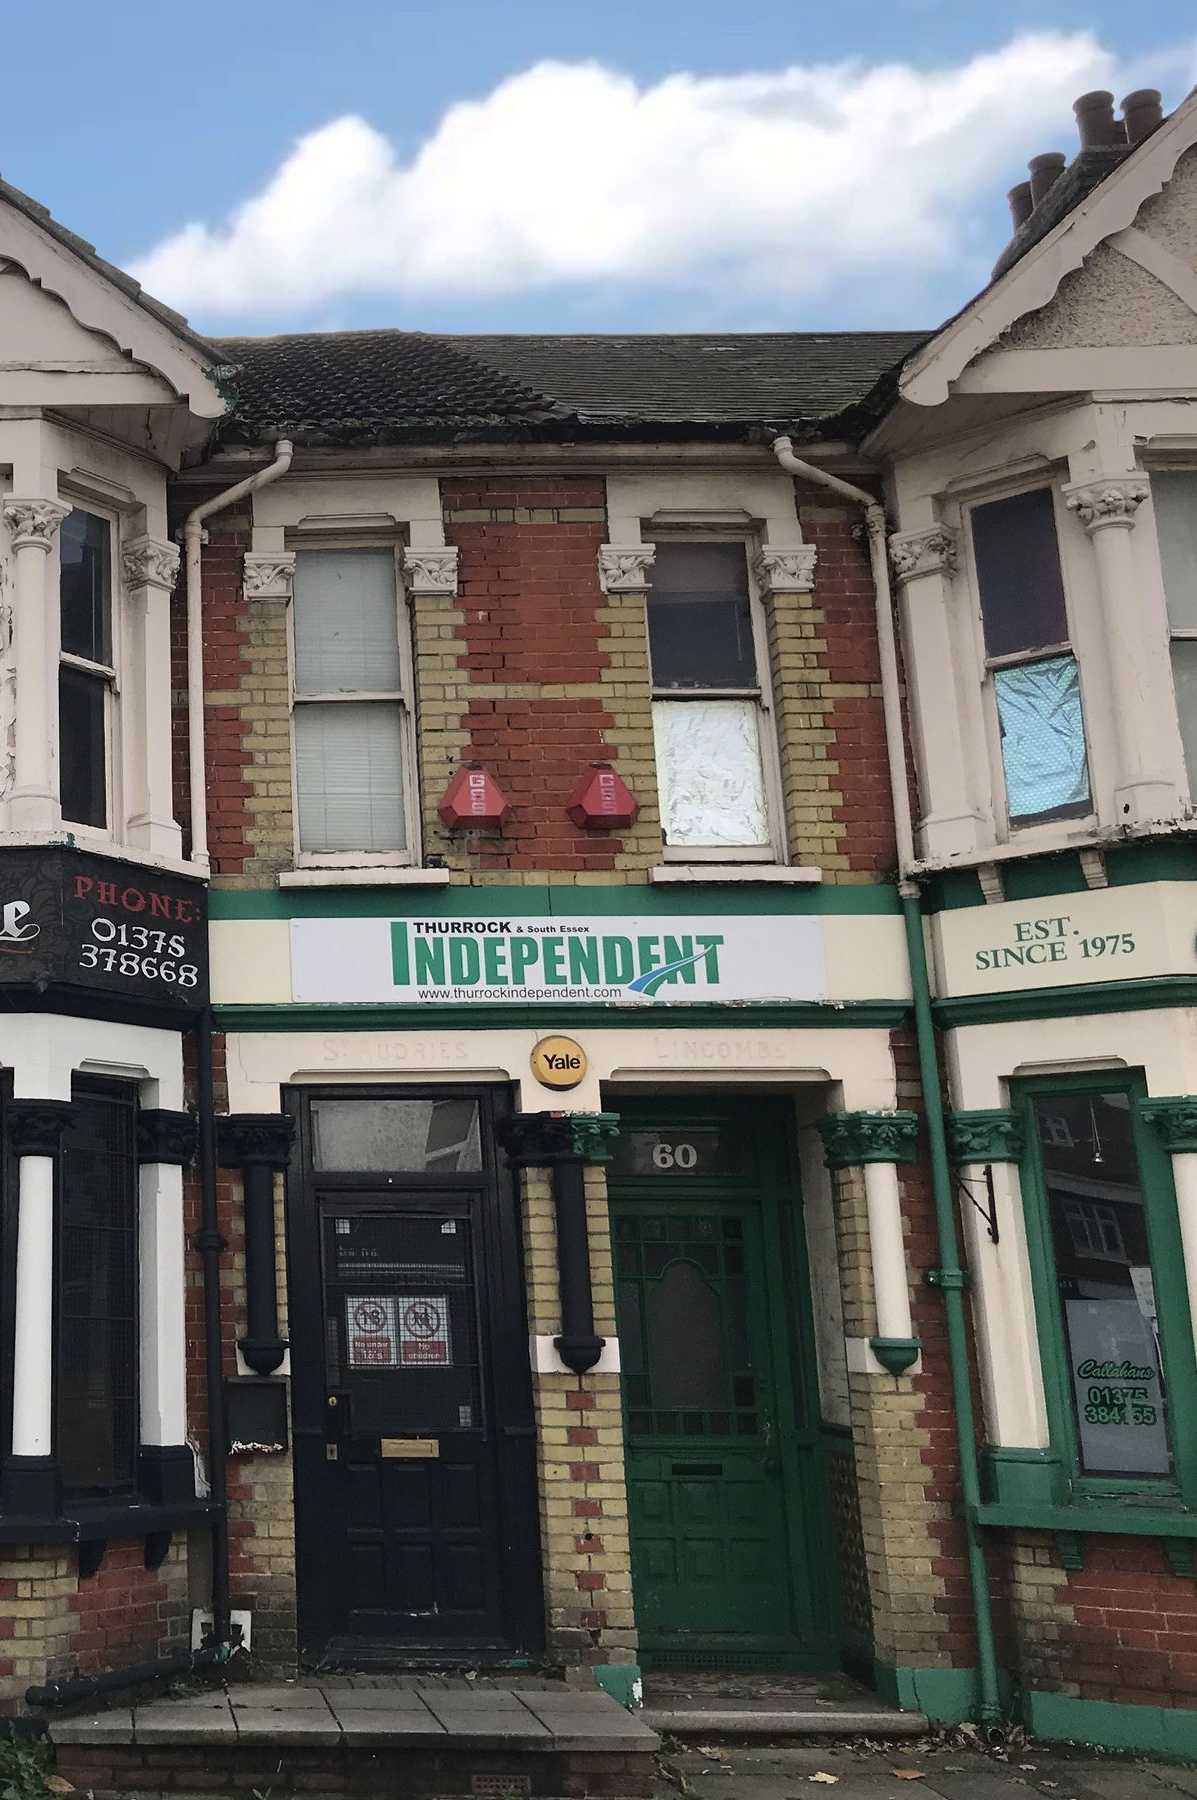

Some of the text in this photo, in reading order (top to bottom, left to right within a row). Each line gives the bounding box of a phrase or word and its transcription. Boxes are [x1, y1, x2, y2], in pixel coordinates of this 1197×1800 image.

[74, 875, 201, 923] PHONE:
[91, 917, 186, 958] 01375
[413, 921, 512, 934] THURROCK
[527, 925, 557, 933] South
[559, 925, 590, 933] Essex
[1013, 916, 1080, 942] EST.
[390, 921, 724, 986] INDEPENDENT
[975, 932, 1136, 971] SINCE 1975
[79, 944, 199, 988] 378668
[418, 986, 622, 1000] www.thurrockindependent.com
[543, 1053, 581, 1070] Yale
[652, 1143, 698, 1168] 60
[1088, 1387, 1148, 1406] 01375
